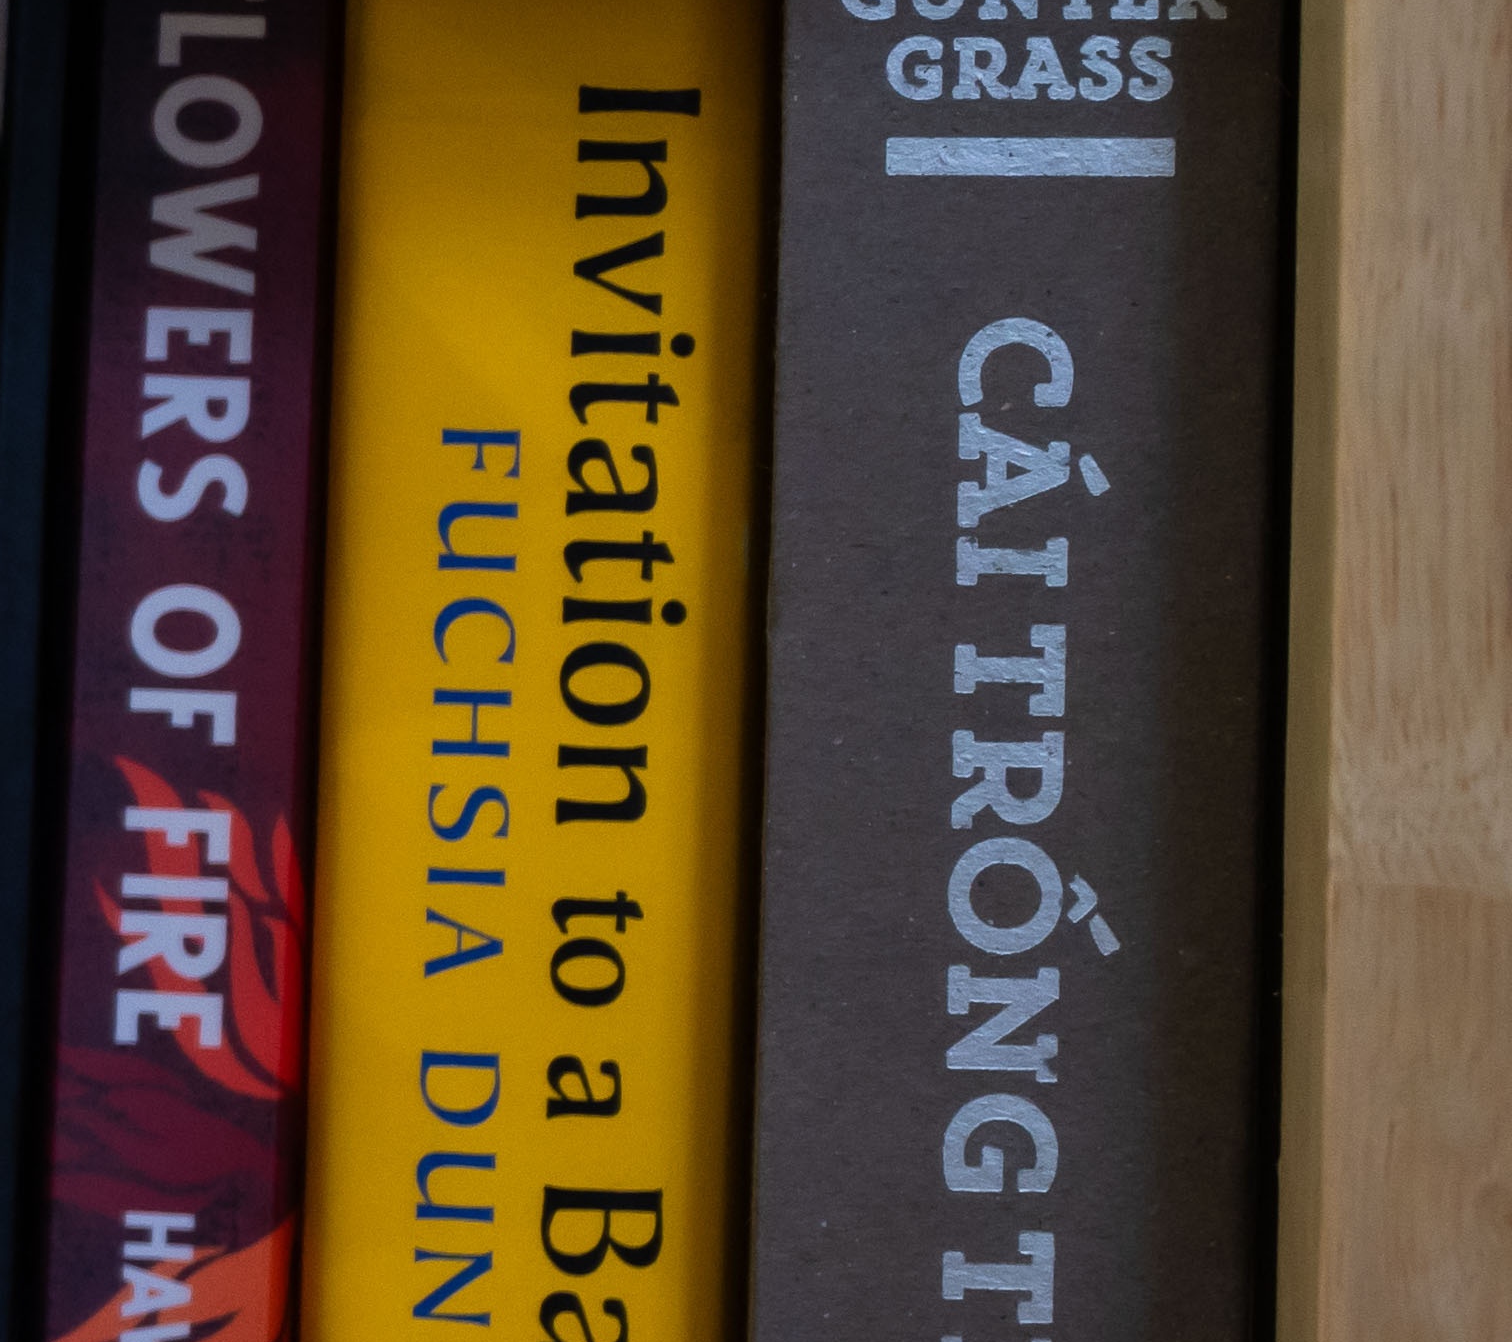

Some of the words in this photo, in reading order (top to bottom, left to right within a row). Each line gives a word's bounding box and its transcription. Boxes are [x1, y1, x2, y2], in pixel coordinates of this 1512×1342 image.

[885, 35, 1176, 103] GRASS
[554, 84, 702, 825] Invitation
[954, 315, 1111, 587] CÁI
[129, 583, 243, 747] OF
[422, 426, 522, 978] FUCHSIA
[114, 804, 233, 1049] FIRE
[548, 890, 645, 1007] to
[942, 623, 1122, 1194] TRỐNG
[545, 1054, 623, 1120] a
